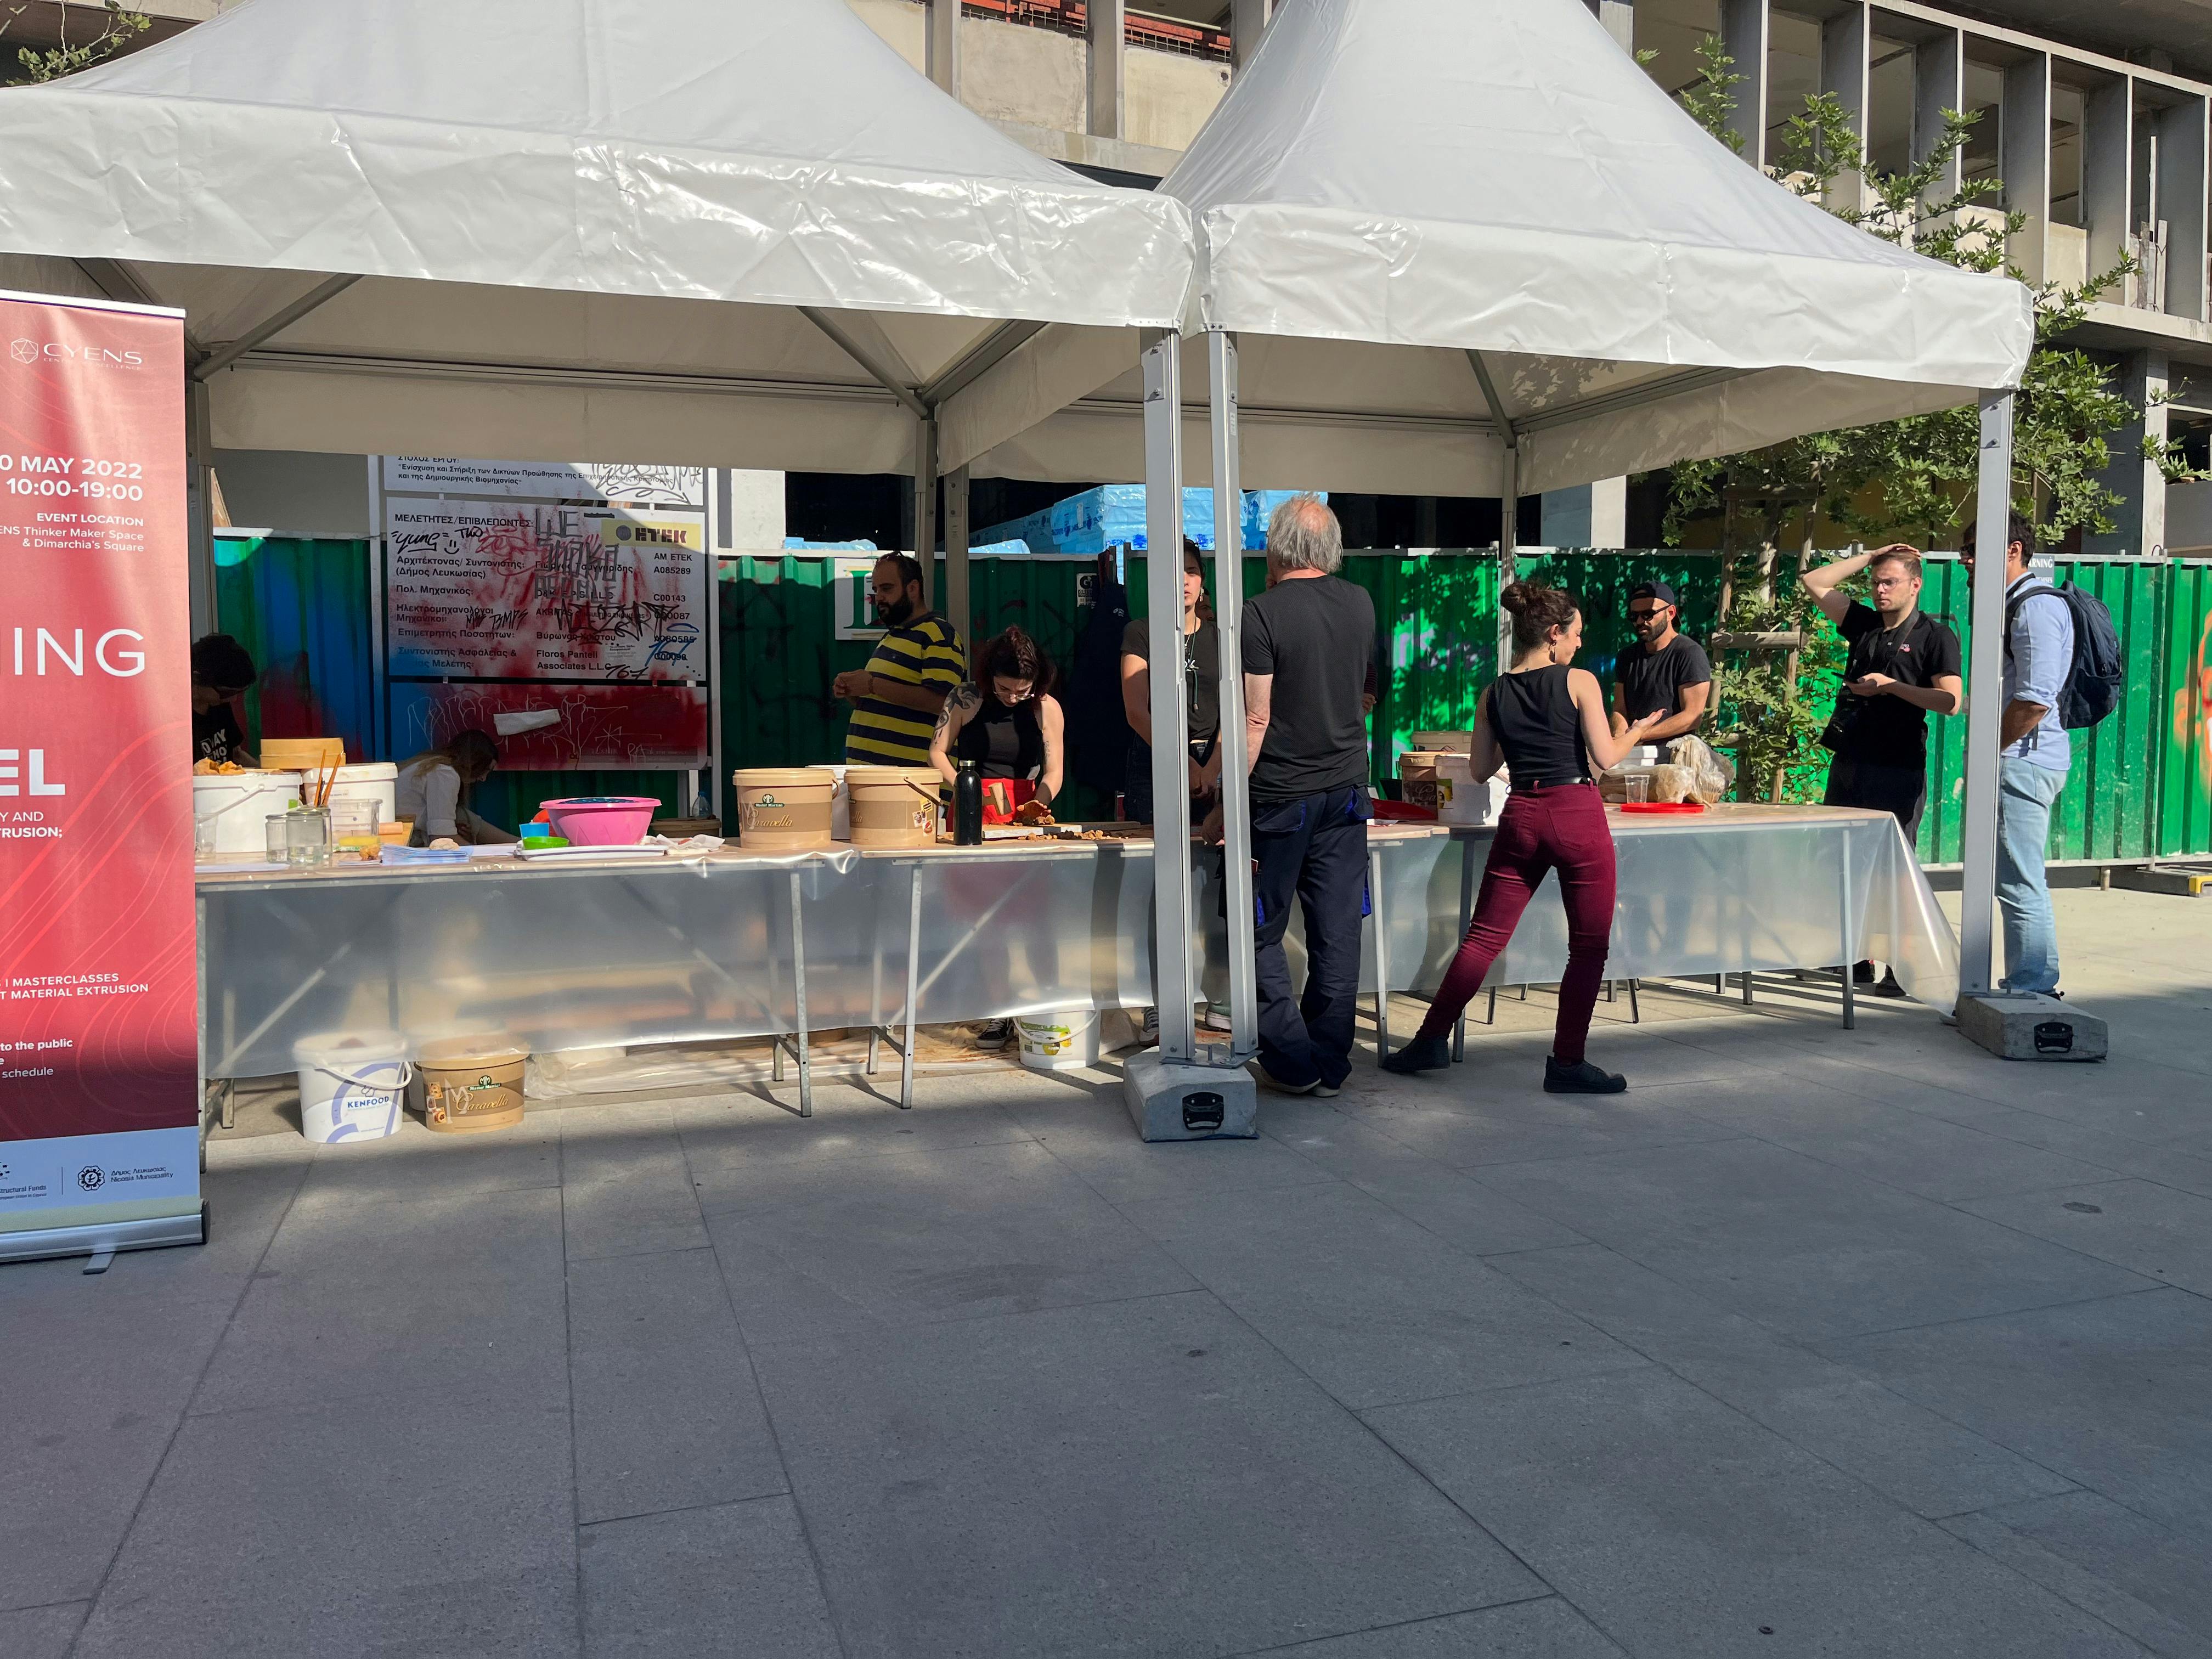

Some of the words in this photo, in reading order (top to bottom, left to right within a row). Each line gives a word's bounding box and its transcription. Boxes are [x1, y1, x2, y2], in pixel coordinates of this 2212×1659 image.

[43, 343, 142, 365] CYENS
[21, 456, 75, 474] MAY
[82, 459, 142, 479] 2022
[426, 474, 473, 483] Δημιουργικής
[522, 470, 562, 478] Προώθησης
[6, 478, 143, 501] 10:00-19:00
[37, 513, 77, 522] EVENT
[81, 515, 144, 527] LOCATION
[24, 527, 67, 537] Thinker
[70, 528, 105, 538] Maker
[109, 530, 144, 541] Space
[22, 538, 30, 547] &
[35, 539, 100, 550] Dimarchia's
[104, 541, 144, 552] Square
[466, 558, 524, 569] Συντονιστής:
[2028, 558, 2053, 568] ARNING
[396, 567, 430, 577] (Δήμος
[432, 568, 486, 579] Λευκωσίας)
[653, 566, 691, 574] A085289
[396, 585, 417, 593] Πολ.
[420, 585, 474, 596] Μηχανικός:
[653, 594, 686, 602] C00143
[398, 628, 457, 640] Επιμετρητής
[460, 629, 515, 639] Ποσοτήτων:
[398, 647, 455, 657] Συντονιστής
[432, 659, 475, 669] Μελέτης:
[537, 662, 586, 670] Associates
[12, 811, 44, 822] AND
[13, 973, 119, 987] MASTERCLASSES
[11, 988, 72, 1000] MATERIAL
[77, 984, 149, 996] EXTRUSION
[15, 1041, 34, 1051] the
[37, 1038, 73, 1051] public
[2, 1066, 54, 1079] schedule
[347, 1096, 389, 1108] KENFOOD
